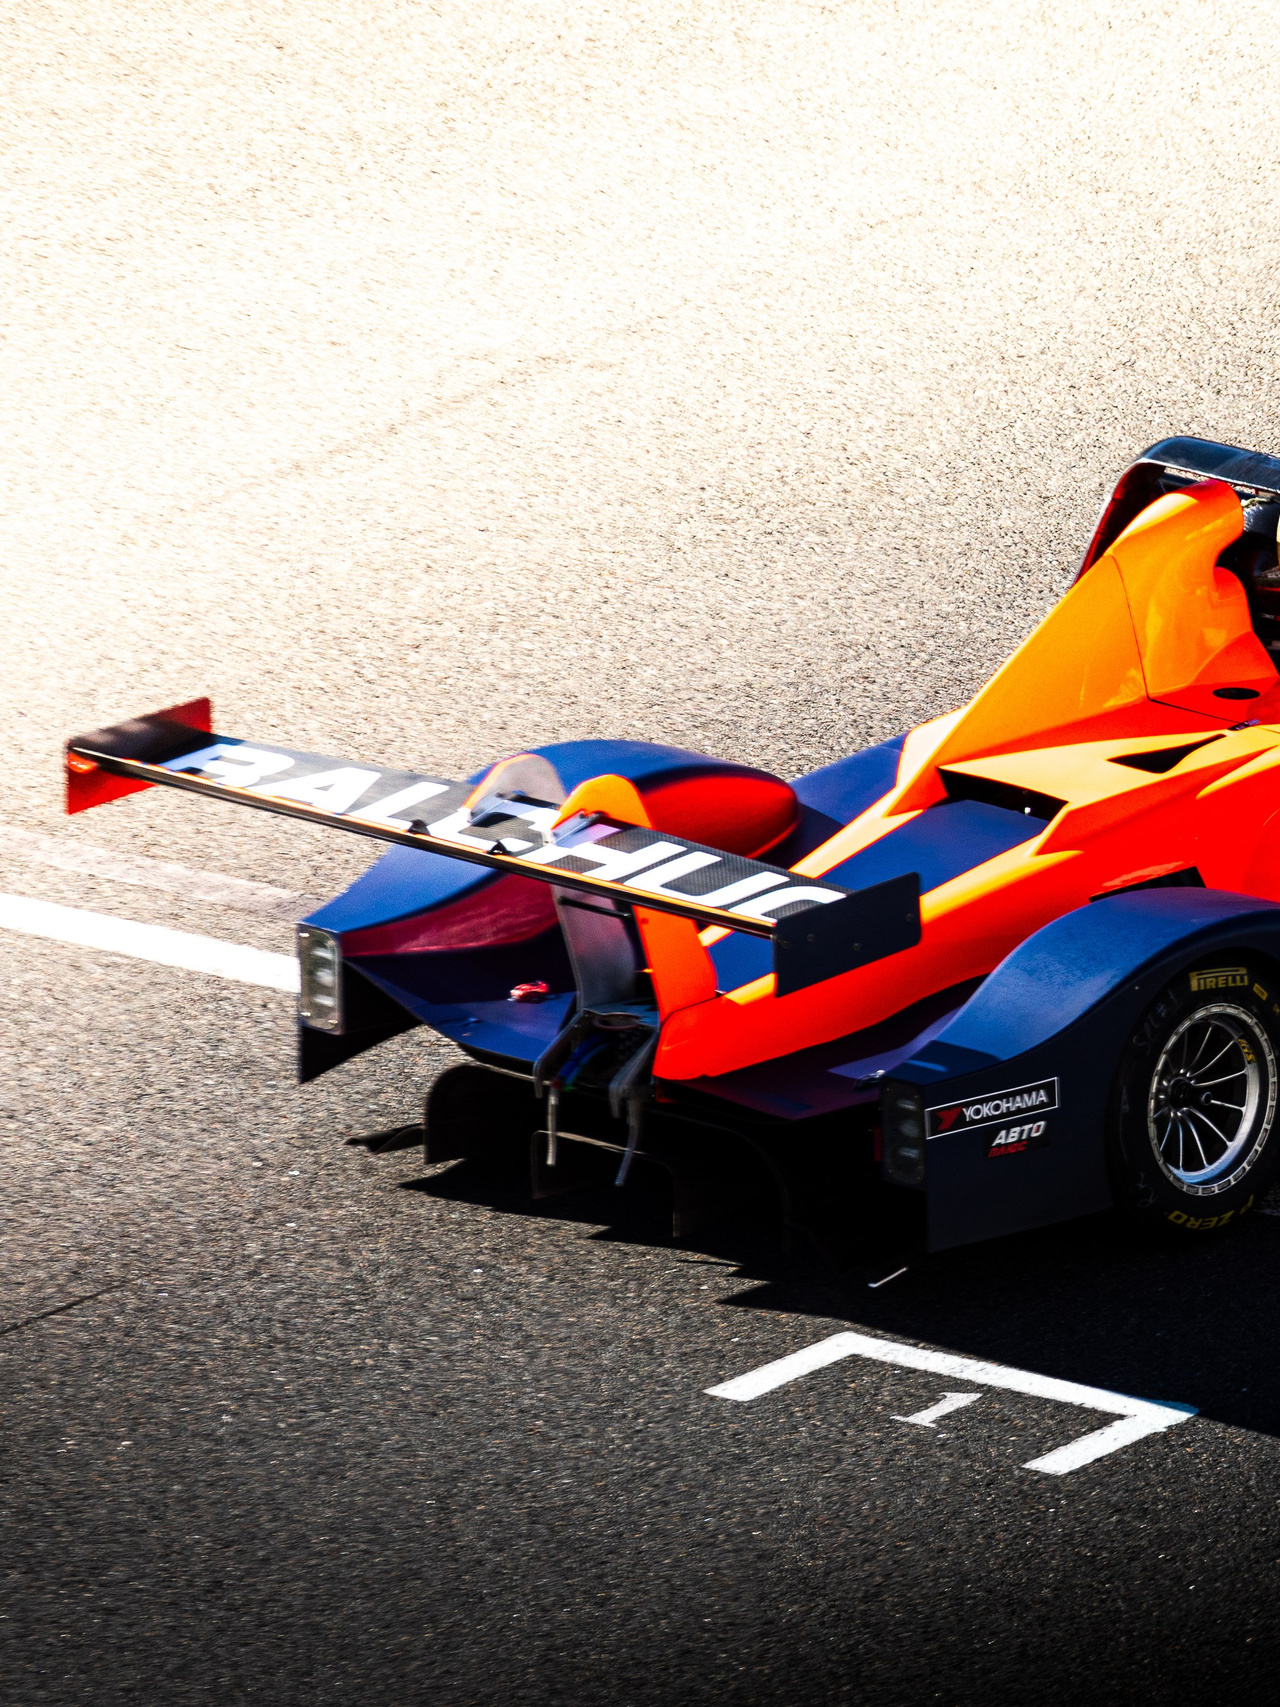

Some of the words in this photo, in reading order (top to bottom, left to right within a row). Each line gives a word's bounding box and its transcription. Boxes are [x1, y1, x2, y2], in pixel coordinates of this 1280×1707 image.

[1188, 966, 1249, 992] PIRELLI
[963, 1089, 1049, 1122] YOKOHAMA
[991, 1120, 1047, 1147] АВТО
[1166, 1209, 1236, 1231] ZERO
[890, 1392, 983, 1427] 1
